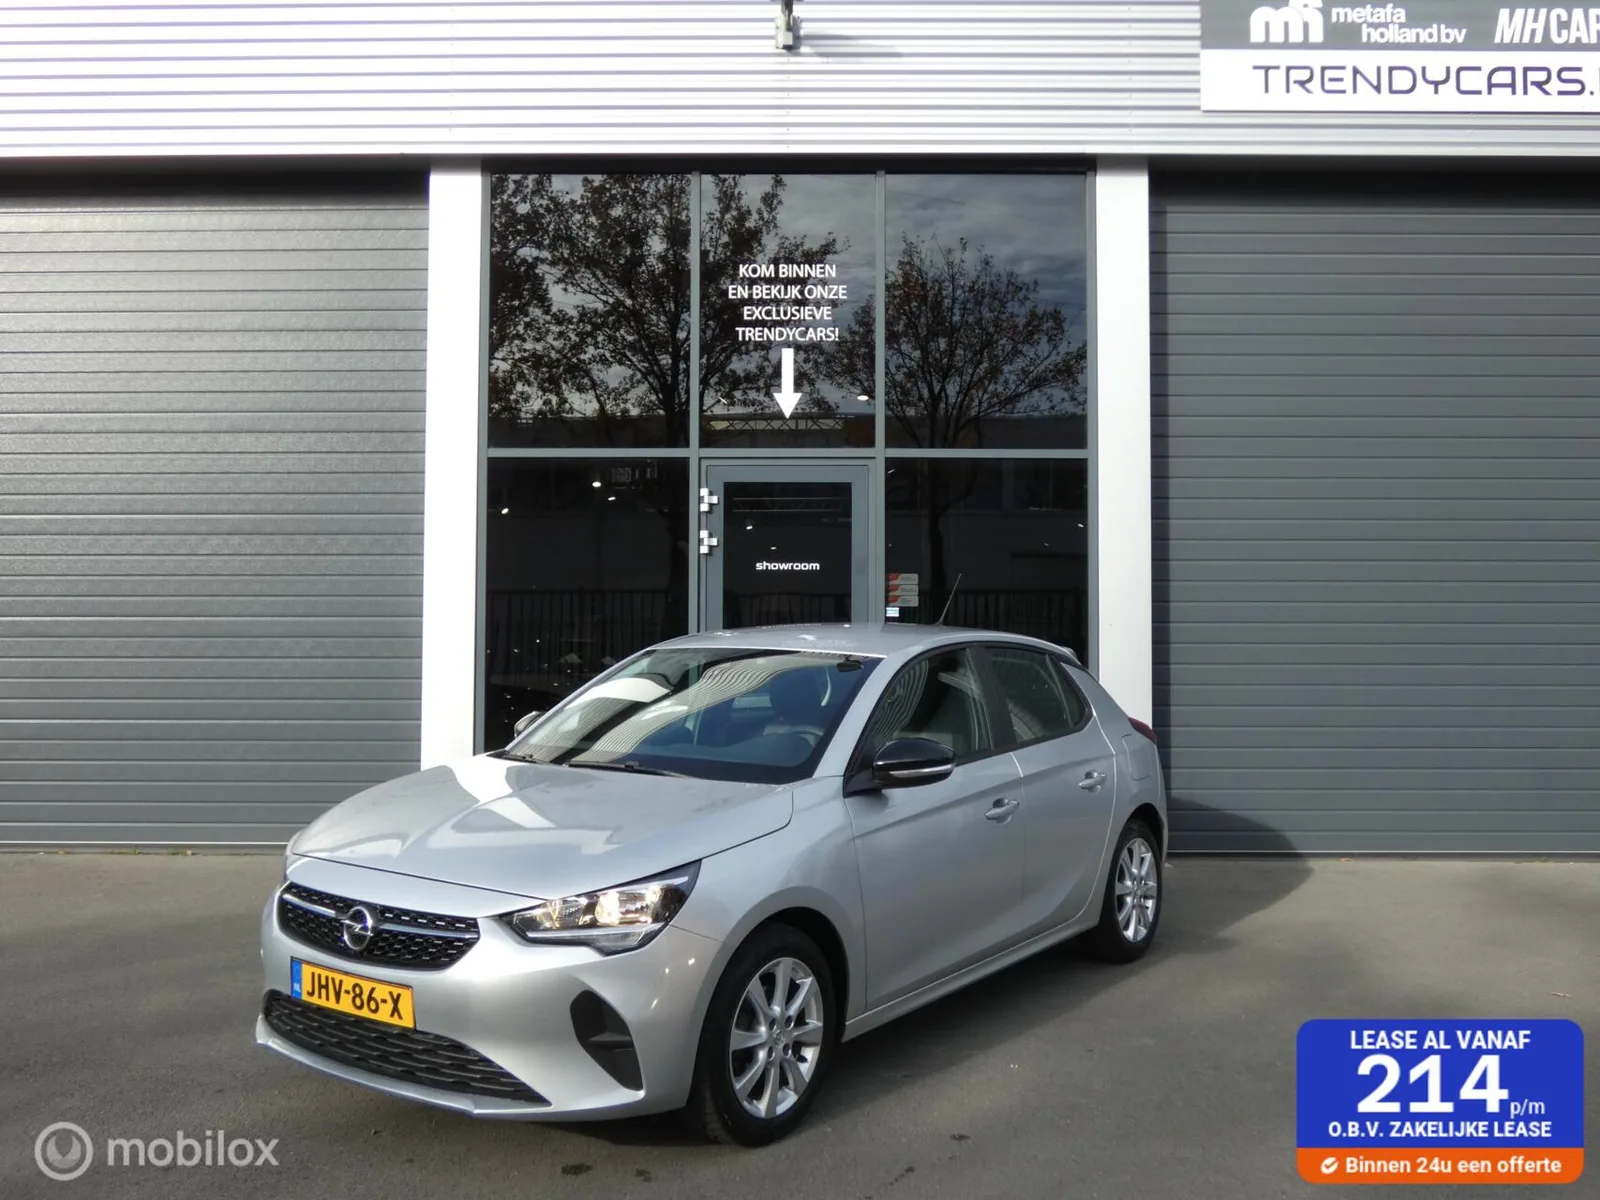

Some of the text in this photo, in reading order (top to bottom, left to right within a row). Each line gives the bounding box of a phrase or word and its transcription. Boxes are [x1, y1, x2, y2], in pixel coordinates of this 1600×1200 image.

[1331, 3, 1406, 23] metafa
[1252, 65, 1600, 96] TRENDYCARS.
[739, 264, 836, 278] KOM BINNEN
[728, 285, 847, 299] EN BEKIJK ONZE
[743, 306, 832, 320] EXCLUSIEVE
[735, 327, 839, 341] TRENDYCARS!
[755, 561, 820, 571] showroom
[306, 971, 404, 1020] JHV-86-X
